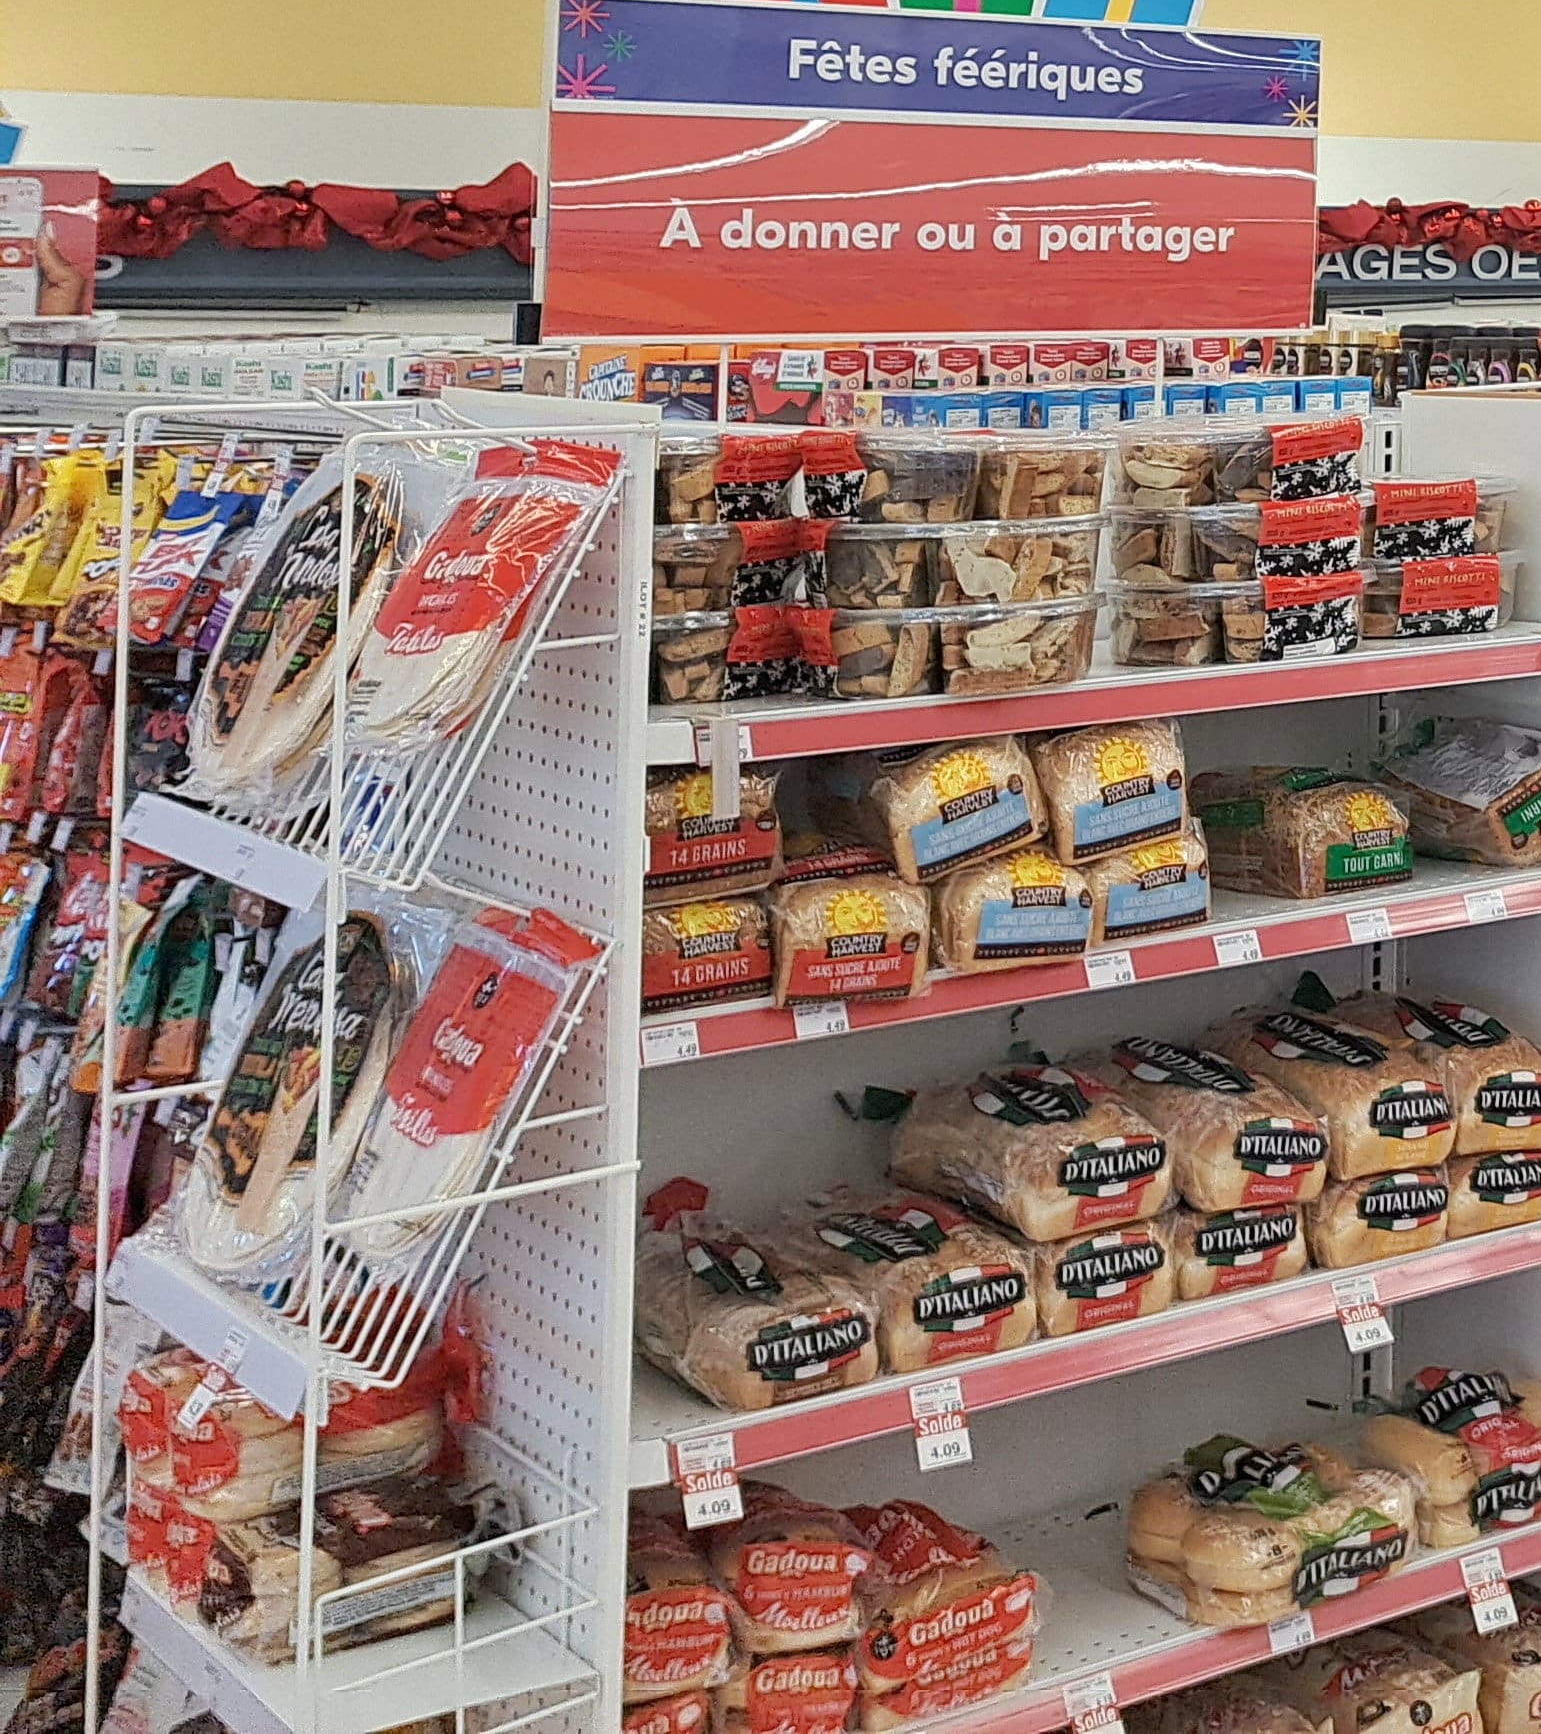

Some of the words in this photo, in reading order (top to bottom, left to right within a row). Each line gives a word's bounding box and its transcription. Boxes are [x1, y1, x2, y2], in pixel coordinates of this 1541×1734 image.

[789, 38, 916, 85] Fêtes
[934, 45, 1144, 101] féériques
[660, 197, 701, 247] À
[720, 209, 900, 251] donner
[917, 223, 976, 251] ou
[992, 208, 1023, 252] à
[1039, 214, 1235, 261] partager
[1391, 490, 1416, 498] MINI
[1421, 484, 1463, 496] BISCOTTI
[1415, 578, 1439, 586] MINI
[1444, 574, 1485, 582] BISCOTTI
[1104, 778, 1150, 796] COUNTRY
[1108, 786, 1151, 804] HARVEST
[943, 788, 994, 812] COUNTRY
[947, 796, 994, 820] HARVEST
[1356, 831, 1392, 841] COUNTRY
[670, 849, 688, 866] 14
[693, 839, 746, 862] GRAINS
[1344, 855, 1370, 874] TOUT
[1142, 867, 1184, 882] COUNTRY
[1144, 874, 1182, 889] HARVEST
[1016, 888, 1063, 899] COUNTRY
[1018, 895, 1062, 906] HARVEST
[682, 932, 737, 948] COUNTRY
[684, 941, 737, 958] HARVEST
[831, 935, 884, 948] COUNTRY
[832, 943, 881, 956] HARVEST
[672, 968, 691, 985] 14
[696, 959, 750, 982] GRAINS
[843, 975, 877, 989] GRAINS
[827, 1020, 846, 1032] 4.49
[677, 1044, 697, 1057] 4.49
[1238, 1132, 1323, 1158] D'ITALIANO
[1063, 1147, 1161, 1183] D'ITALIANO
[1365, 1187, 1447, 1214] D'ITALIANO
[1200, 1217, 1294, 1252] D'ITALIANO
[1061, 1245, 1159, 1285] D'ITALIANO
[918, 1277, 1020, 1320] D'ITALIANO
[1342, 1303, 1381, 1325] Solde
[753, 1320, 863, 1368] D'ITALIANO
[1356, 1327, 1382, 1342] 4.09
[919, 1413, 964, 1435] Solde
[931, 1441, 961, 1460] 4.09
[686, 1470, 733, 1494] Solde
[699, 1499, 731, 1517] 4.09
[748, 1549, 837, 1575] Gadoua
[1470, 1582, 1507, 1603] Solde
[910, 1600, 994, 1646] Gadoua
[1483, 1606, 1509, 1623] 4.09
[755, 1667, 840, 1693] Gadoua
